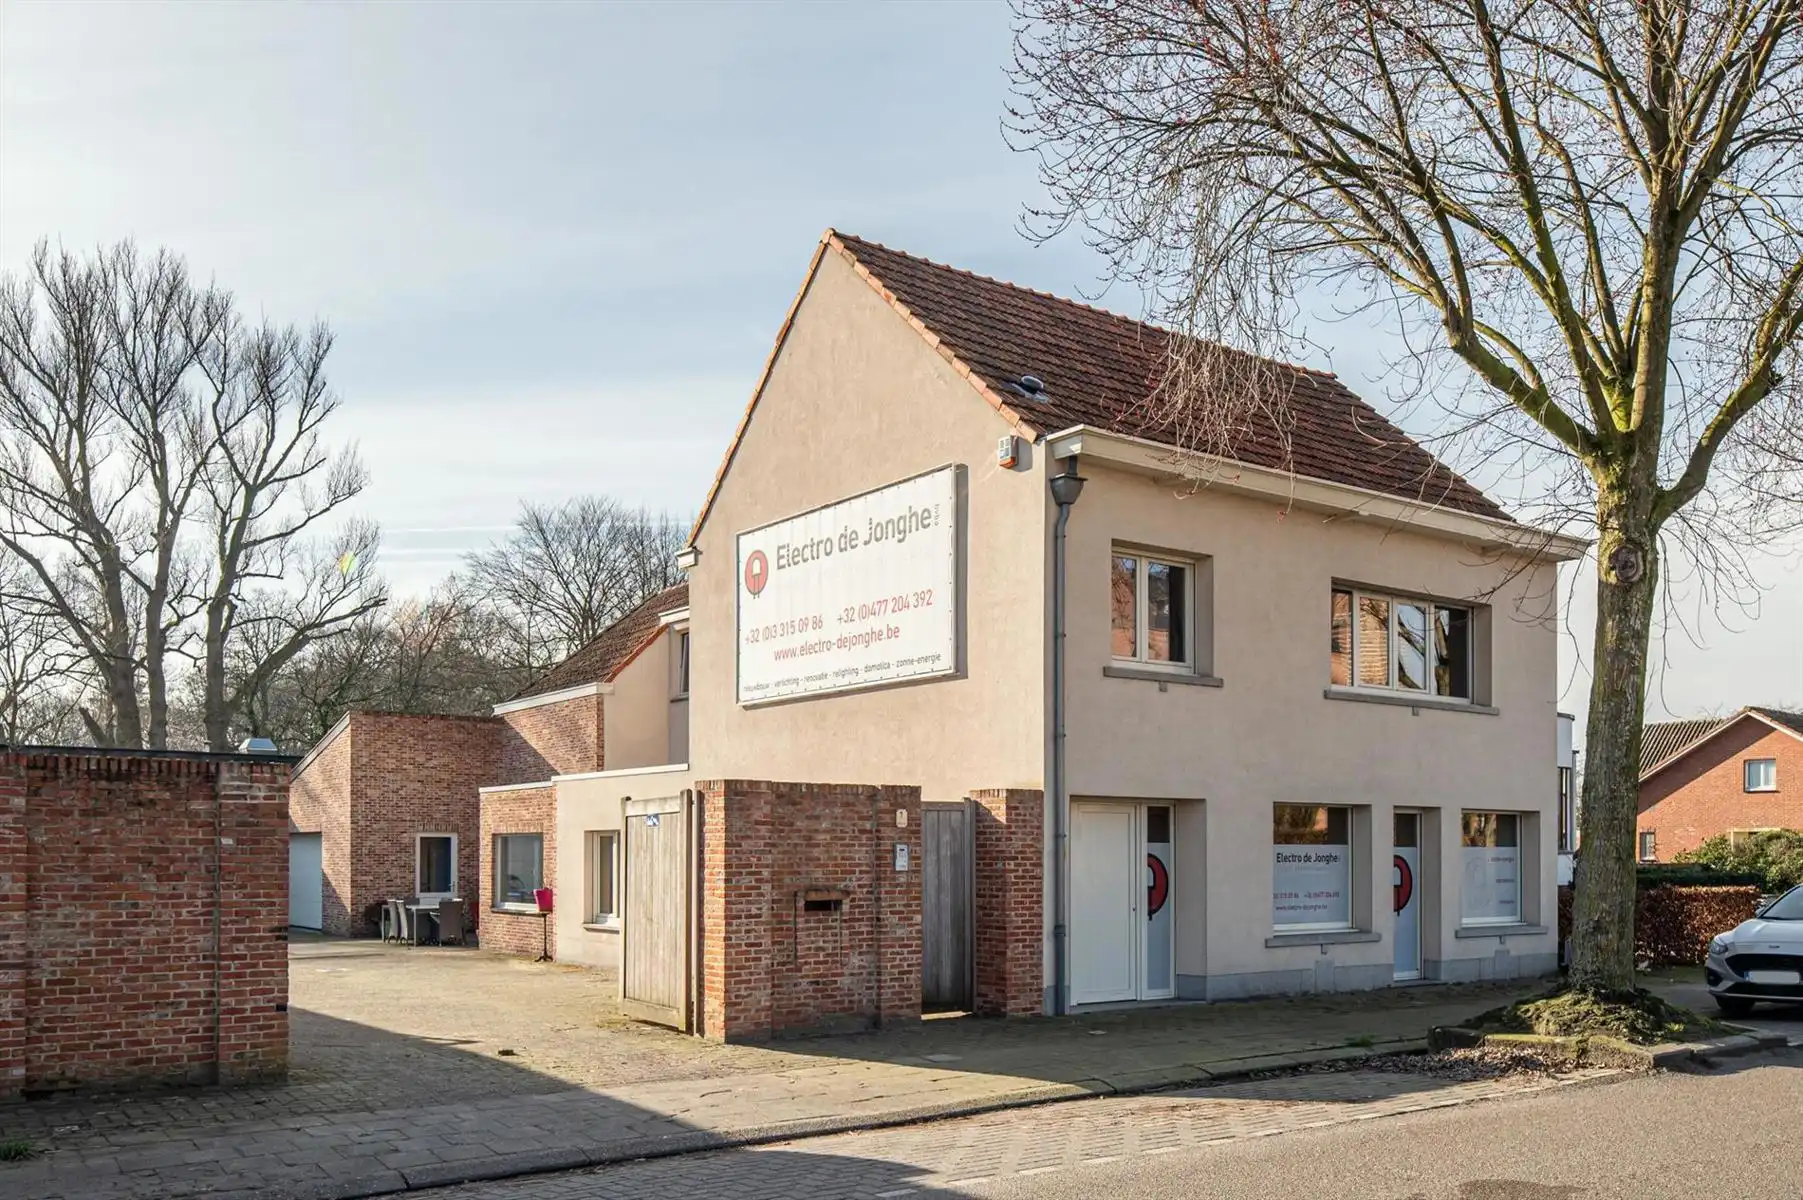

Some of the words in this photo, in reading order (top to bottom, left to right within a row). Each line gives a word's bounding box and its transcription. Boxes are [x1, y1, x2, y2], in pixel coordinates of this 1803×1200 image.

[776, 536, 834, 570] Electro
[838, 525, 859, 553] de
[863, 505, 932, 546] Jonghe
[837, 605, 856, 625] +32
[858, 599, 888, 621] (0)477
[891, 593, 910, 614] 204
[912, 588, 933, 609] 392
[745, 625, 760, 645] +32
[762, 622, 778, 642] (0)3
[779, 619, 796, 637] 315
[797, 616, 810, 634] 09
[811, 614, 824, 631] 86
[773, 623, 901, 661] www.electro-dejonghe.be
[864, 661, 891, 674] domotica
[895, 652, 942, 669] zonne-energie
[1276, 852, 1302, 863] Electro
[1303, 852, 1312, 863] de
[1313, 852, 1338, 865] Jonghe
